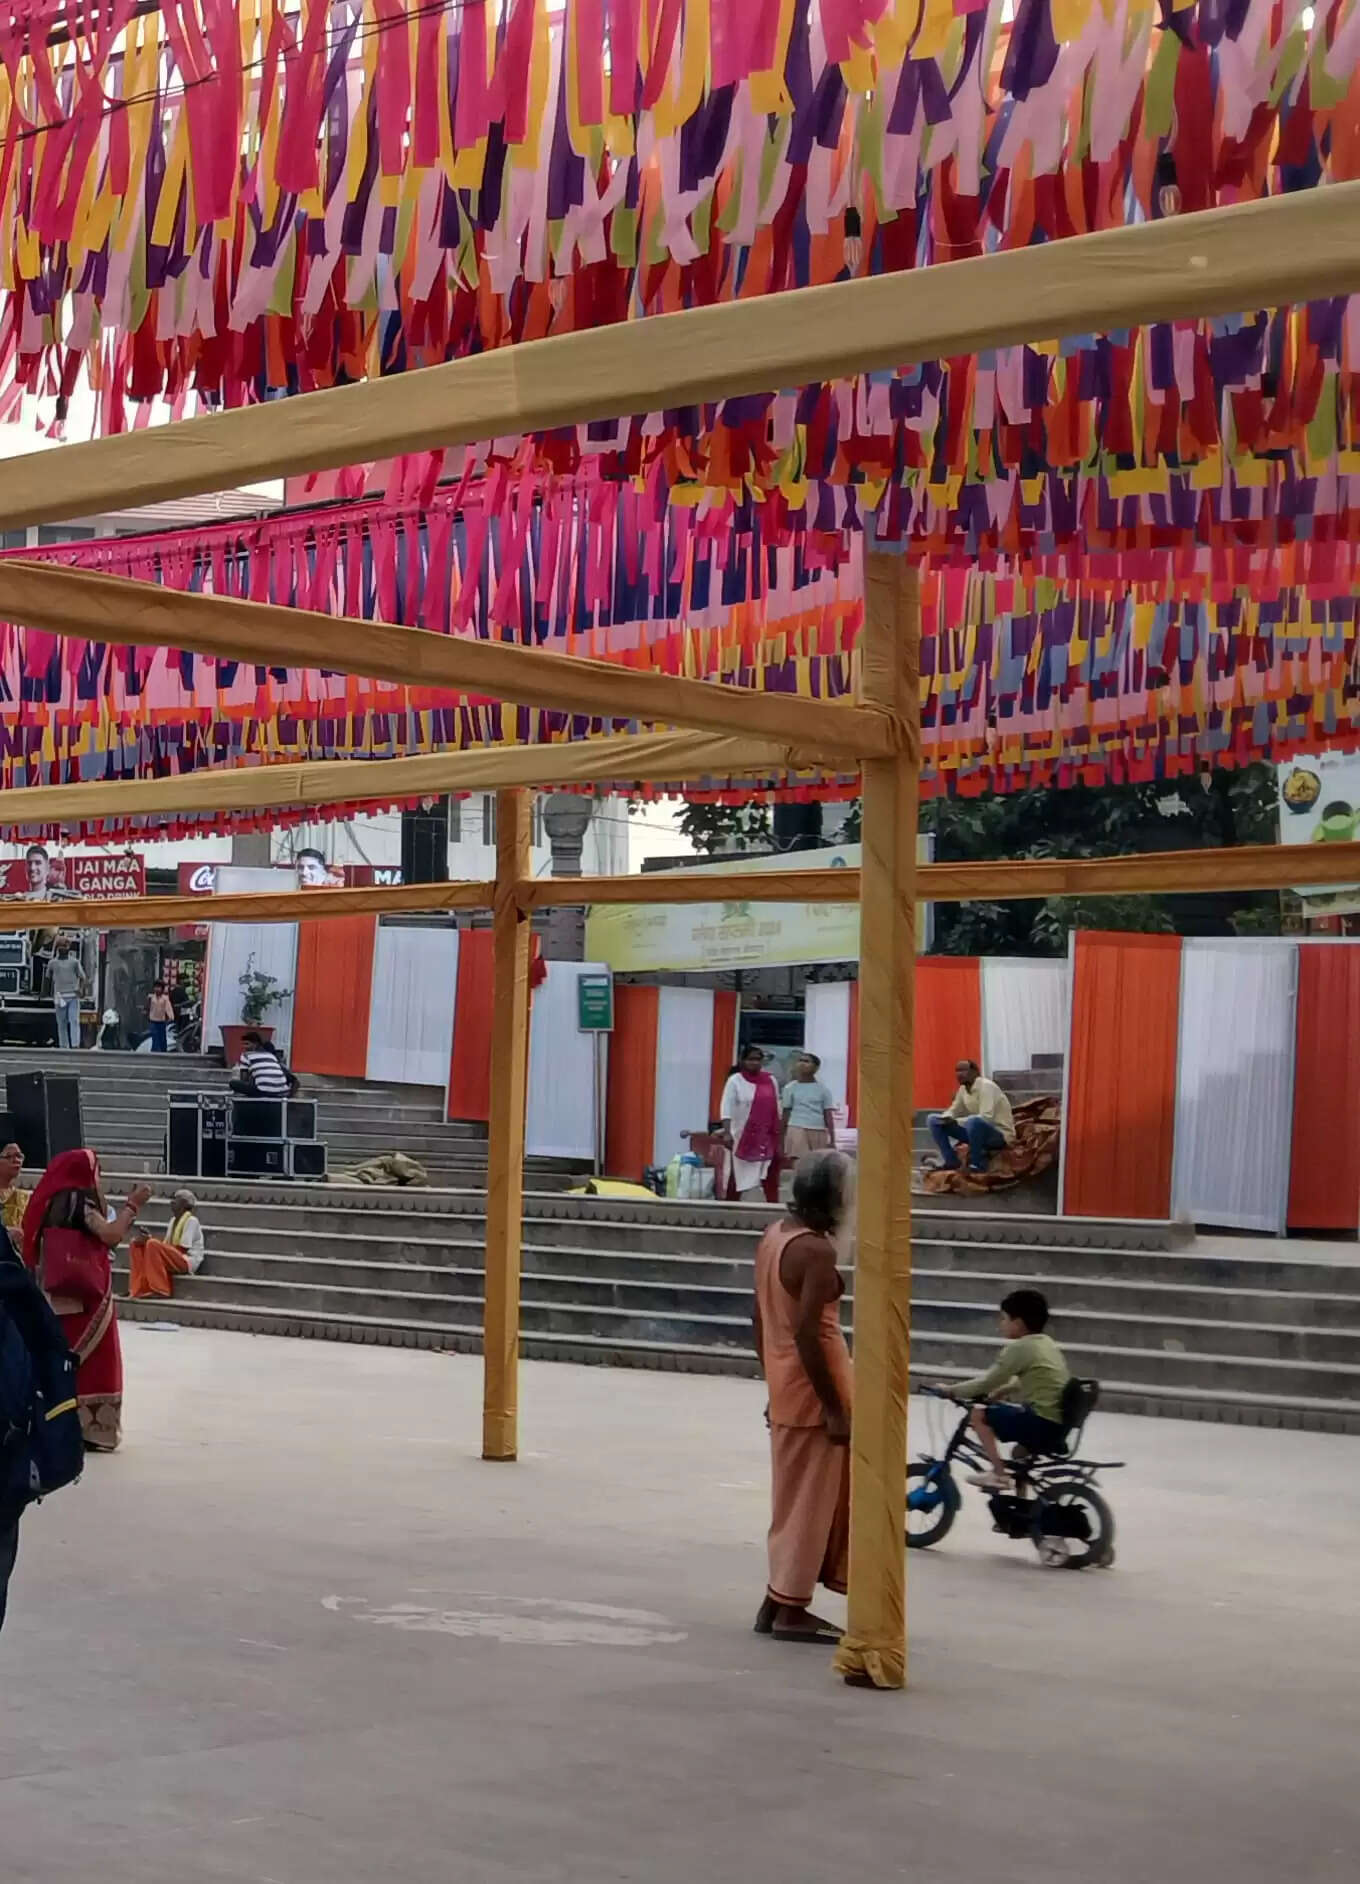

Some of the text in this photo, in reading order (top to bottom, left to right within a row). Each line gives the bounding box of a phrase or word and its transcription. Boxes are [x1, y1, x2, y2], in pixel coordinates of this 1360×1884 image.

[75, 858, 141, 875] JAI MAA
[79, 876, 137, 891] GANGA
